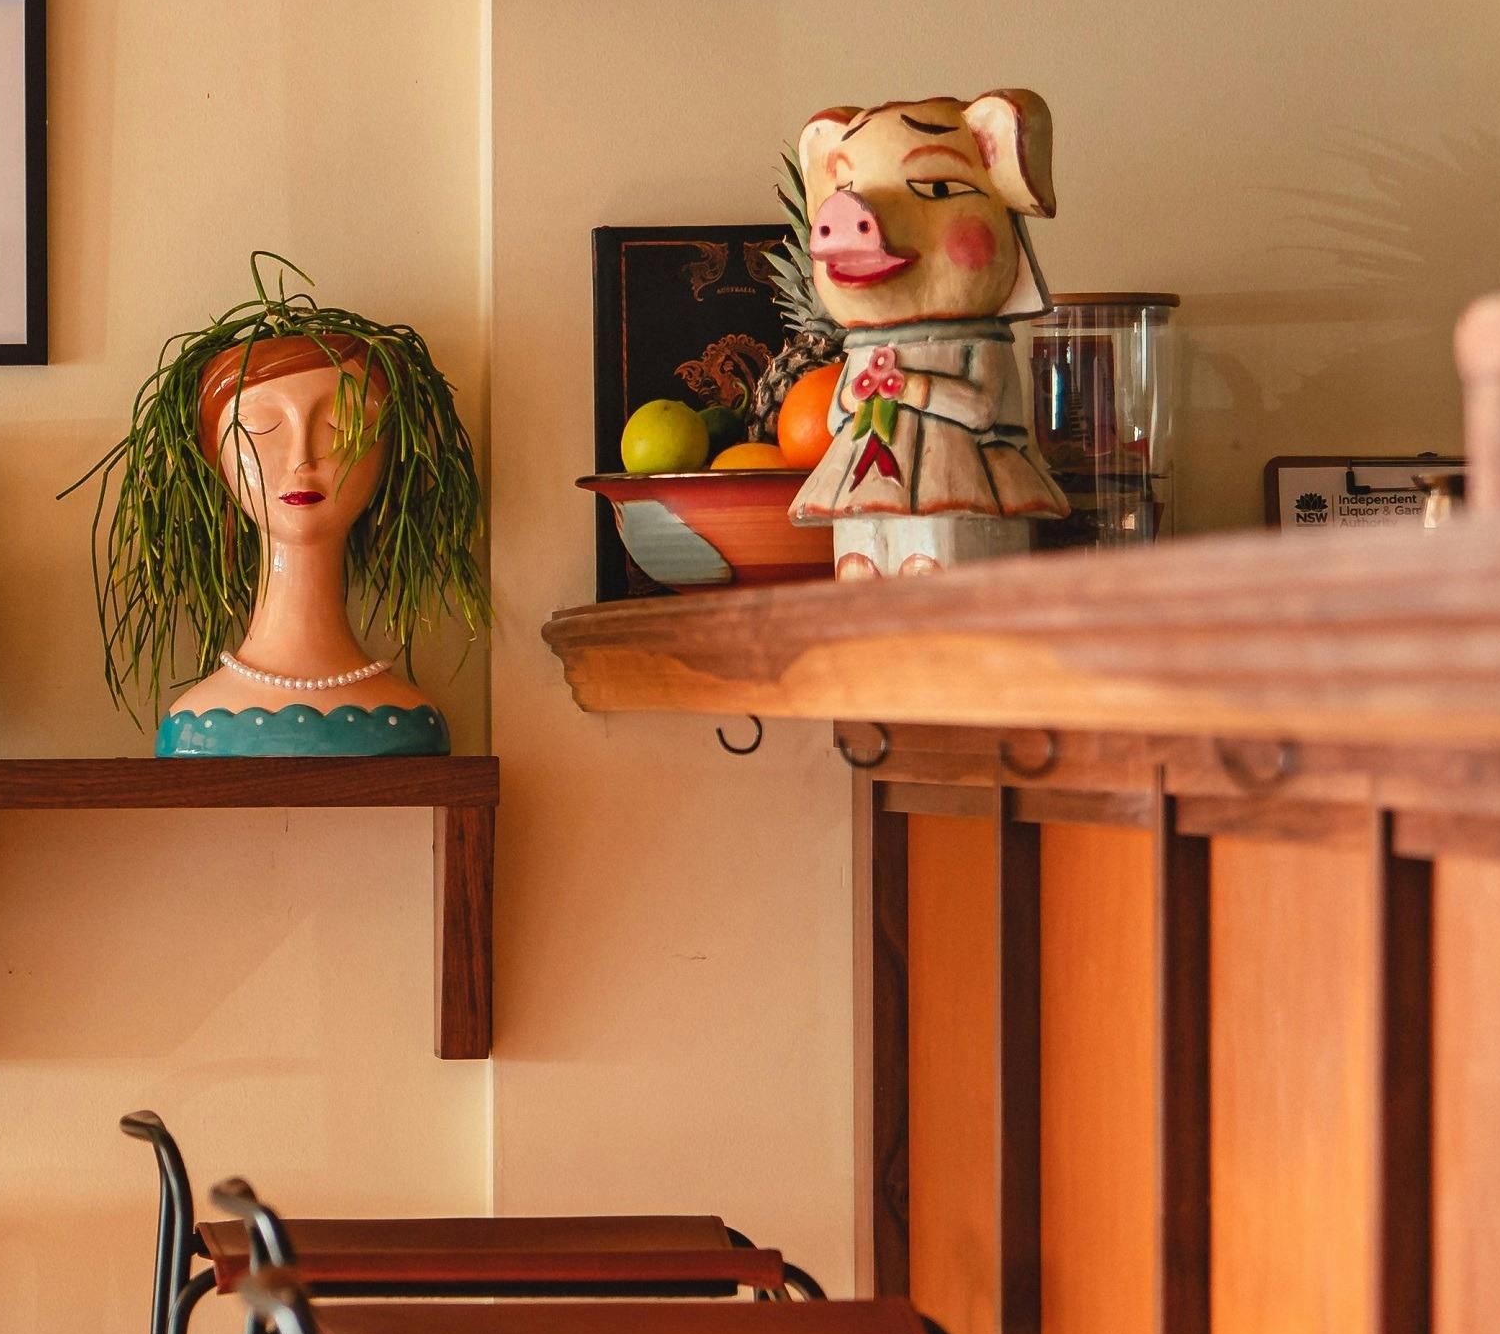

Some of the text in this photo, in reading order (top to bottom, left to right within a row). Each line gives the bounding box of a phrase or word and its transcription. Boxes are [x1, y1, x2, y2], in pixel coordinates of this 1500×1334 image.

[1338, 494, 1417, 507] Independent
[1295, 512, 1329, 524] NSW
[1339, 505, 1380, 518] Liquor
[1383, 505, 1392, 517] &
